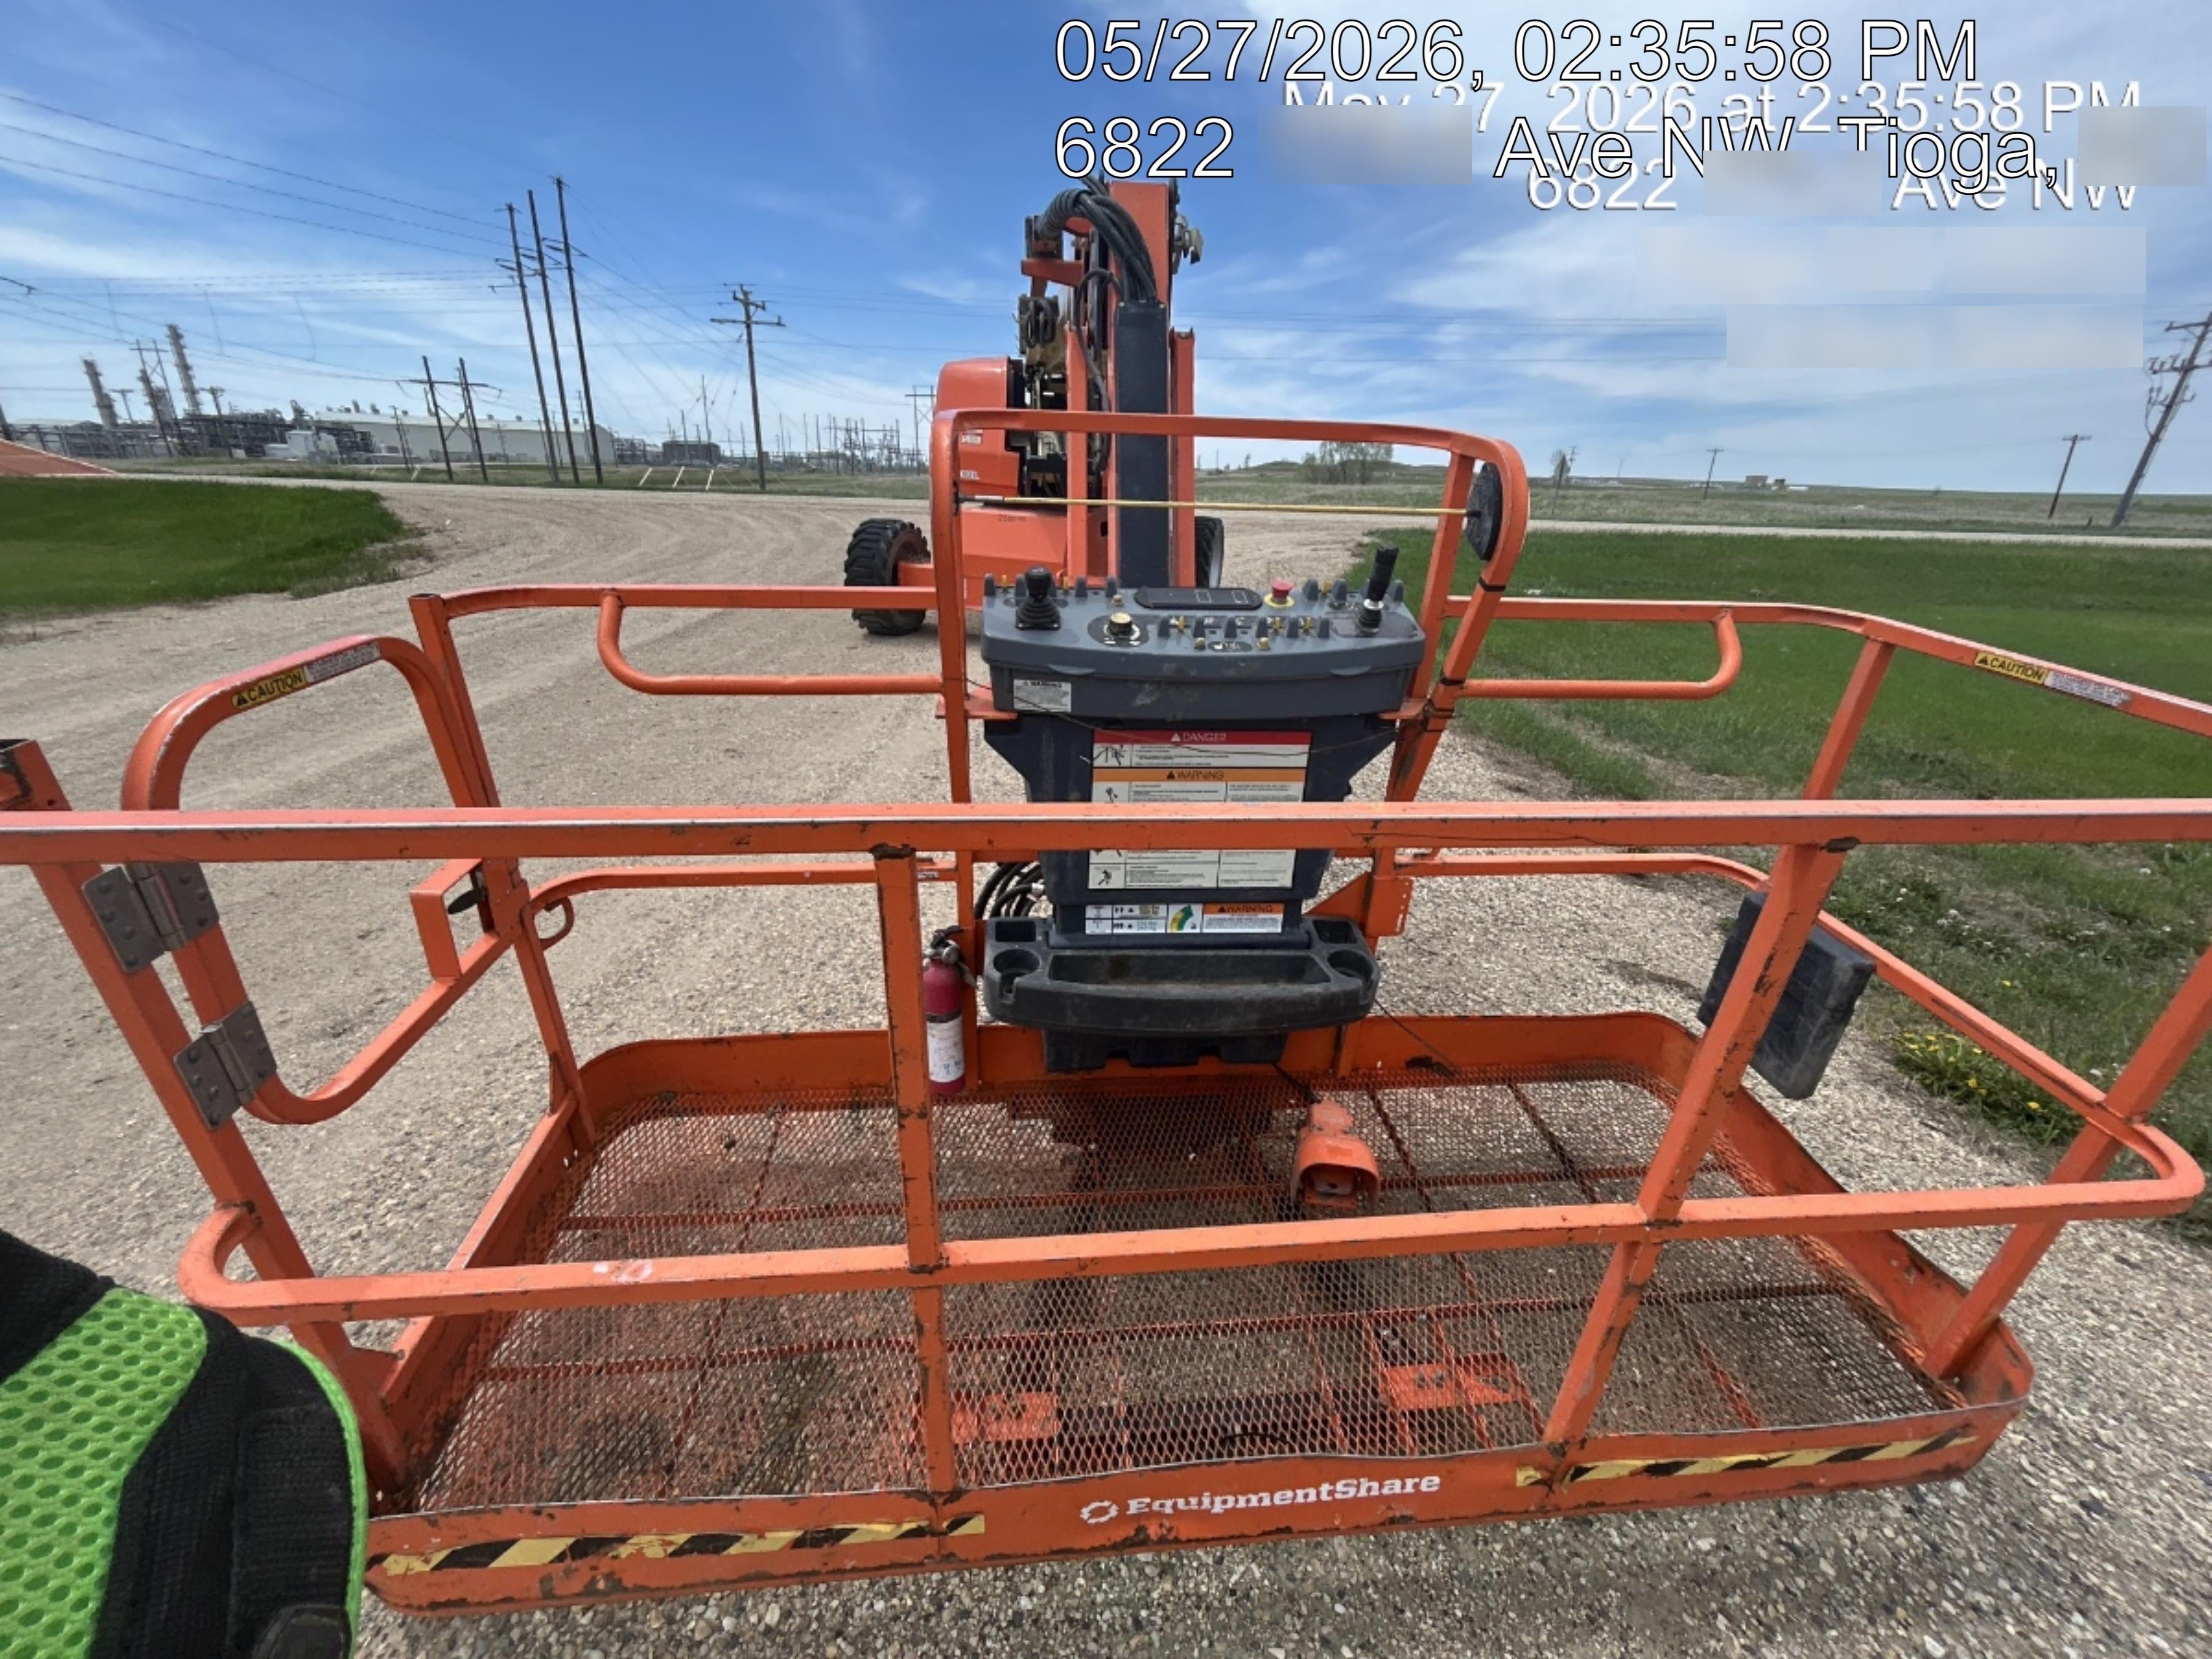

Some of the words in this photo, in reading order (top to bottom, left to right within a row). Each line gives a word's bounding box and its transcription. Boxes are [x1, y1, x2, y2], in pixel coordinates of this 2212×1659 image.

[1990, 657, 2045, 681] CAUTION
[248, 670, 304, 701] CAUTION
[1182, 732, 1227, 742] DANGER
[1177, 771, 1225, 780] WARNING
[1125, 1475, 1441, 1516] EquipmentShare
